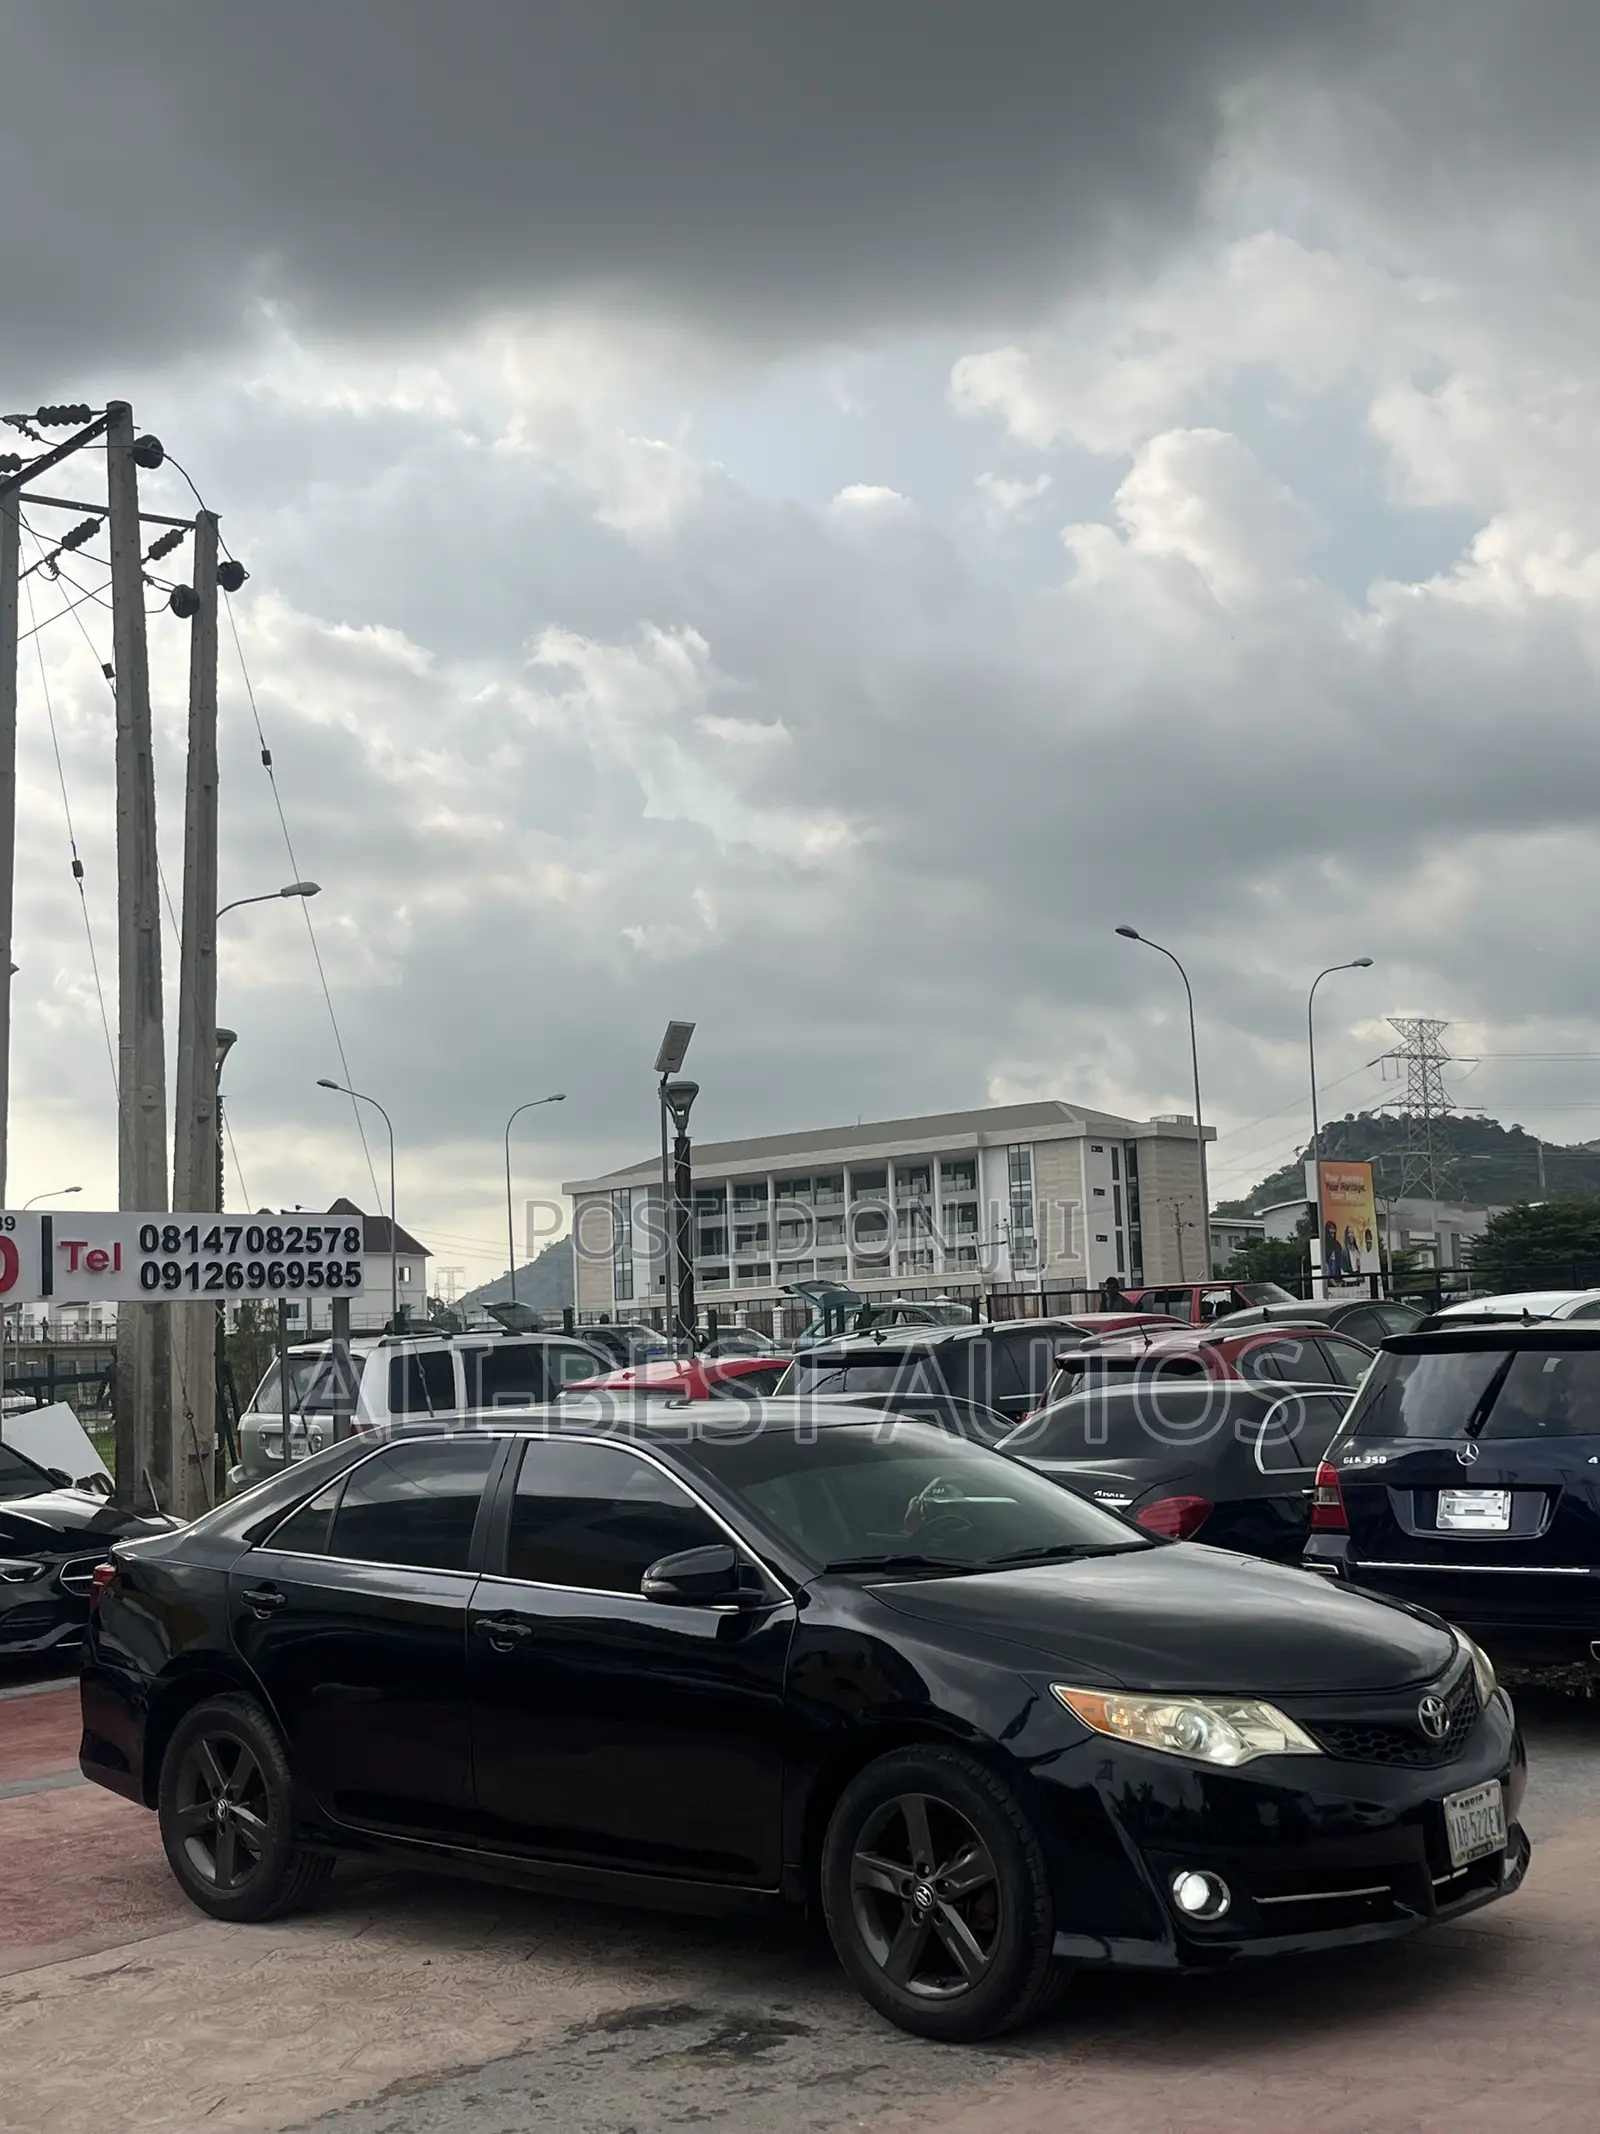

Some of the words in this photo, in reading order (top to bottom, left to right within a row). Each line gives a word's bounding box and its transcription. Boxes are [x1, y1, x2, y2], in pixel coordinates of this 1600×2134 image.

[139, 1224, 361, 1254] 08147082578
[60, 1241, 121, 1272] Tel
[140, 1261, 362, 1290] 09126969585
[1364, 1455, 1387, 1464] 350
